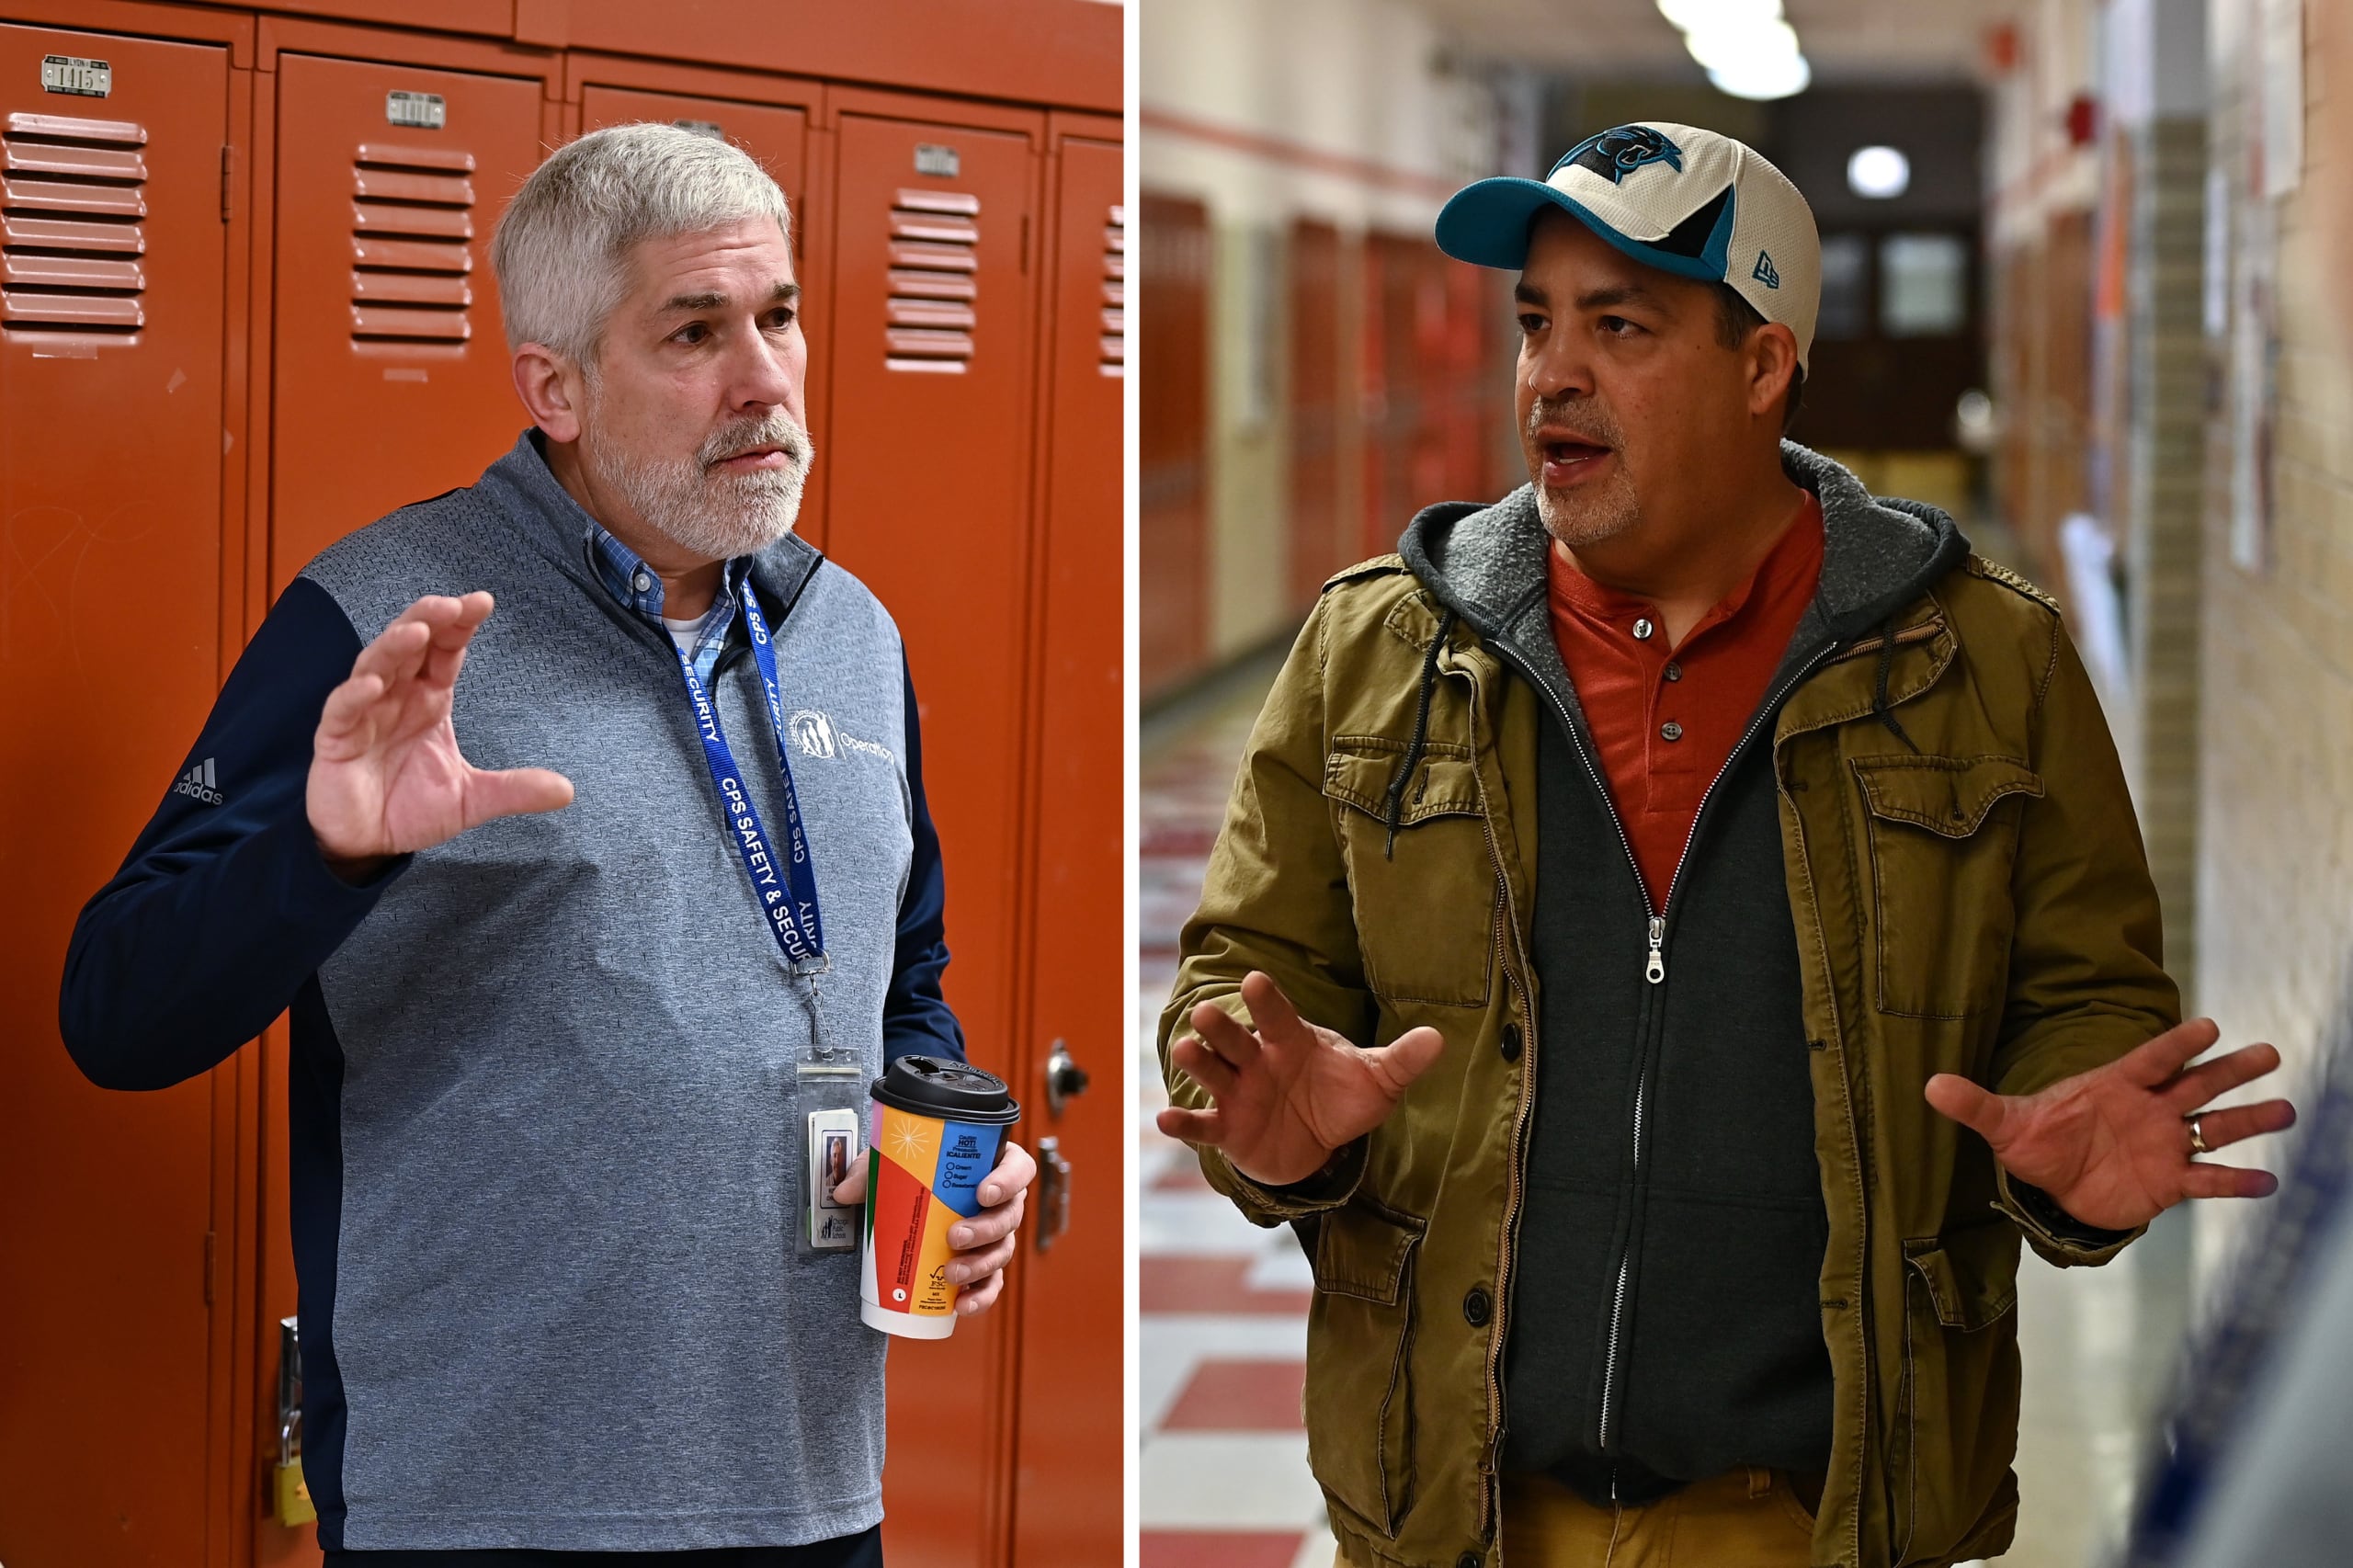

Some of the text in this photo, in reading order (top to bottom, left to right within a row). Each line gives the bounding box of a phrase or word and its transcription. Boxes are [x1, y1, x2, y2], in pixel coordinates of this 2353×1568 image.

[60, 67, 94, 88] 1415
[749, 611, 767, 644] CPS
[681, 653, 720, 743] SECURITY
[174, 780, 223, 805] adidas
[722, 778, 746, 815] CPS
[737, 816, 778, 885] SAFETY
[766, 890, 782, 904] &
[793, 827, 805, 864] CPS
